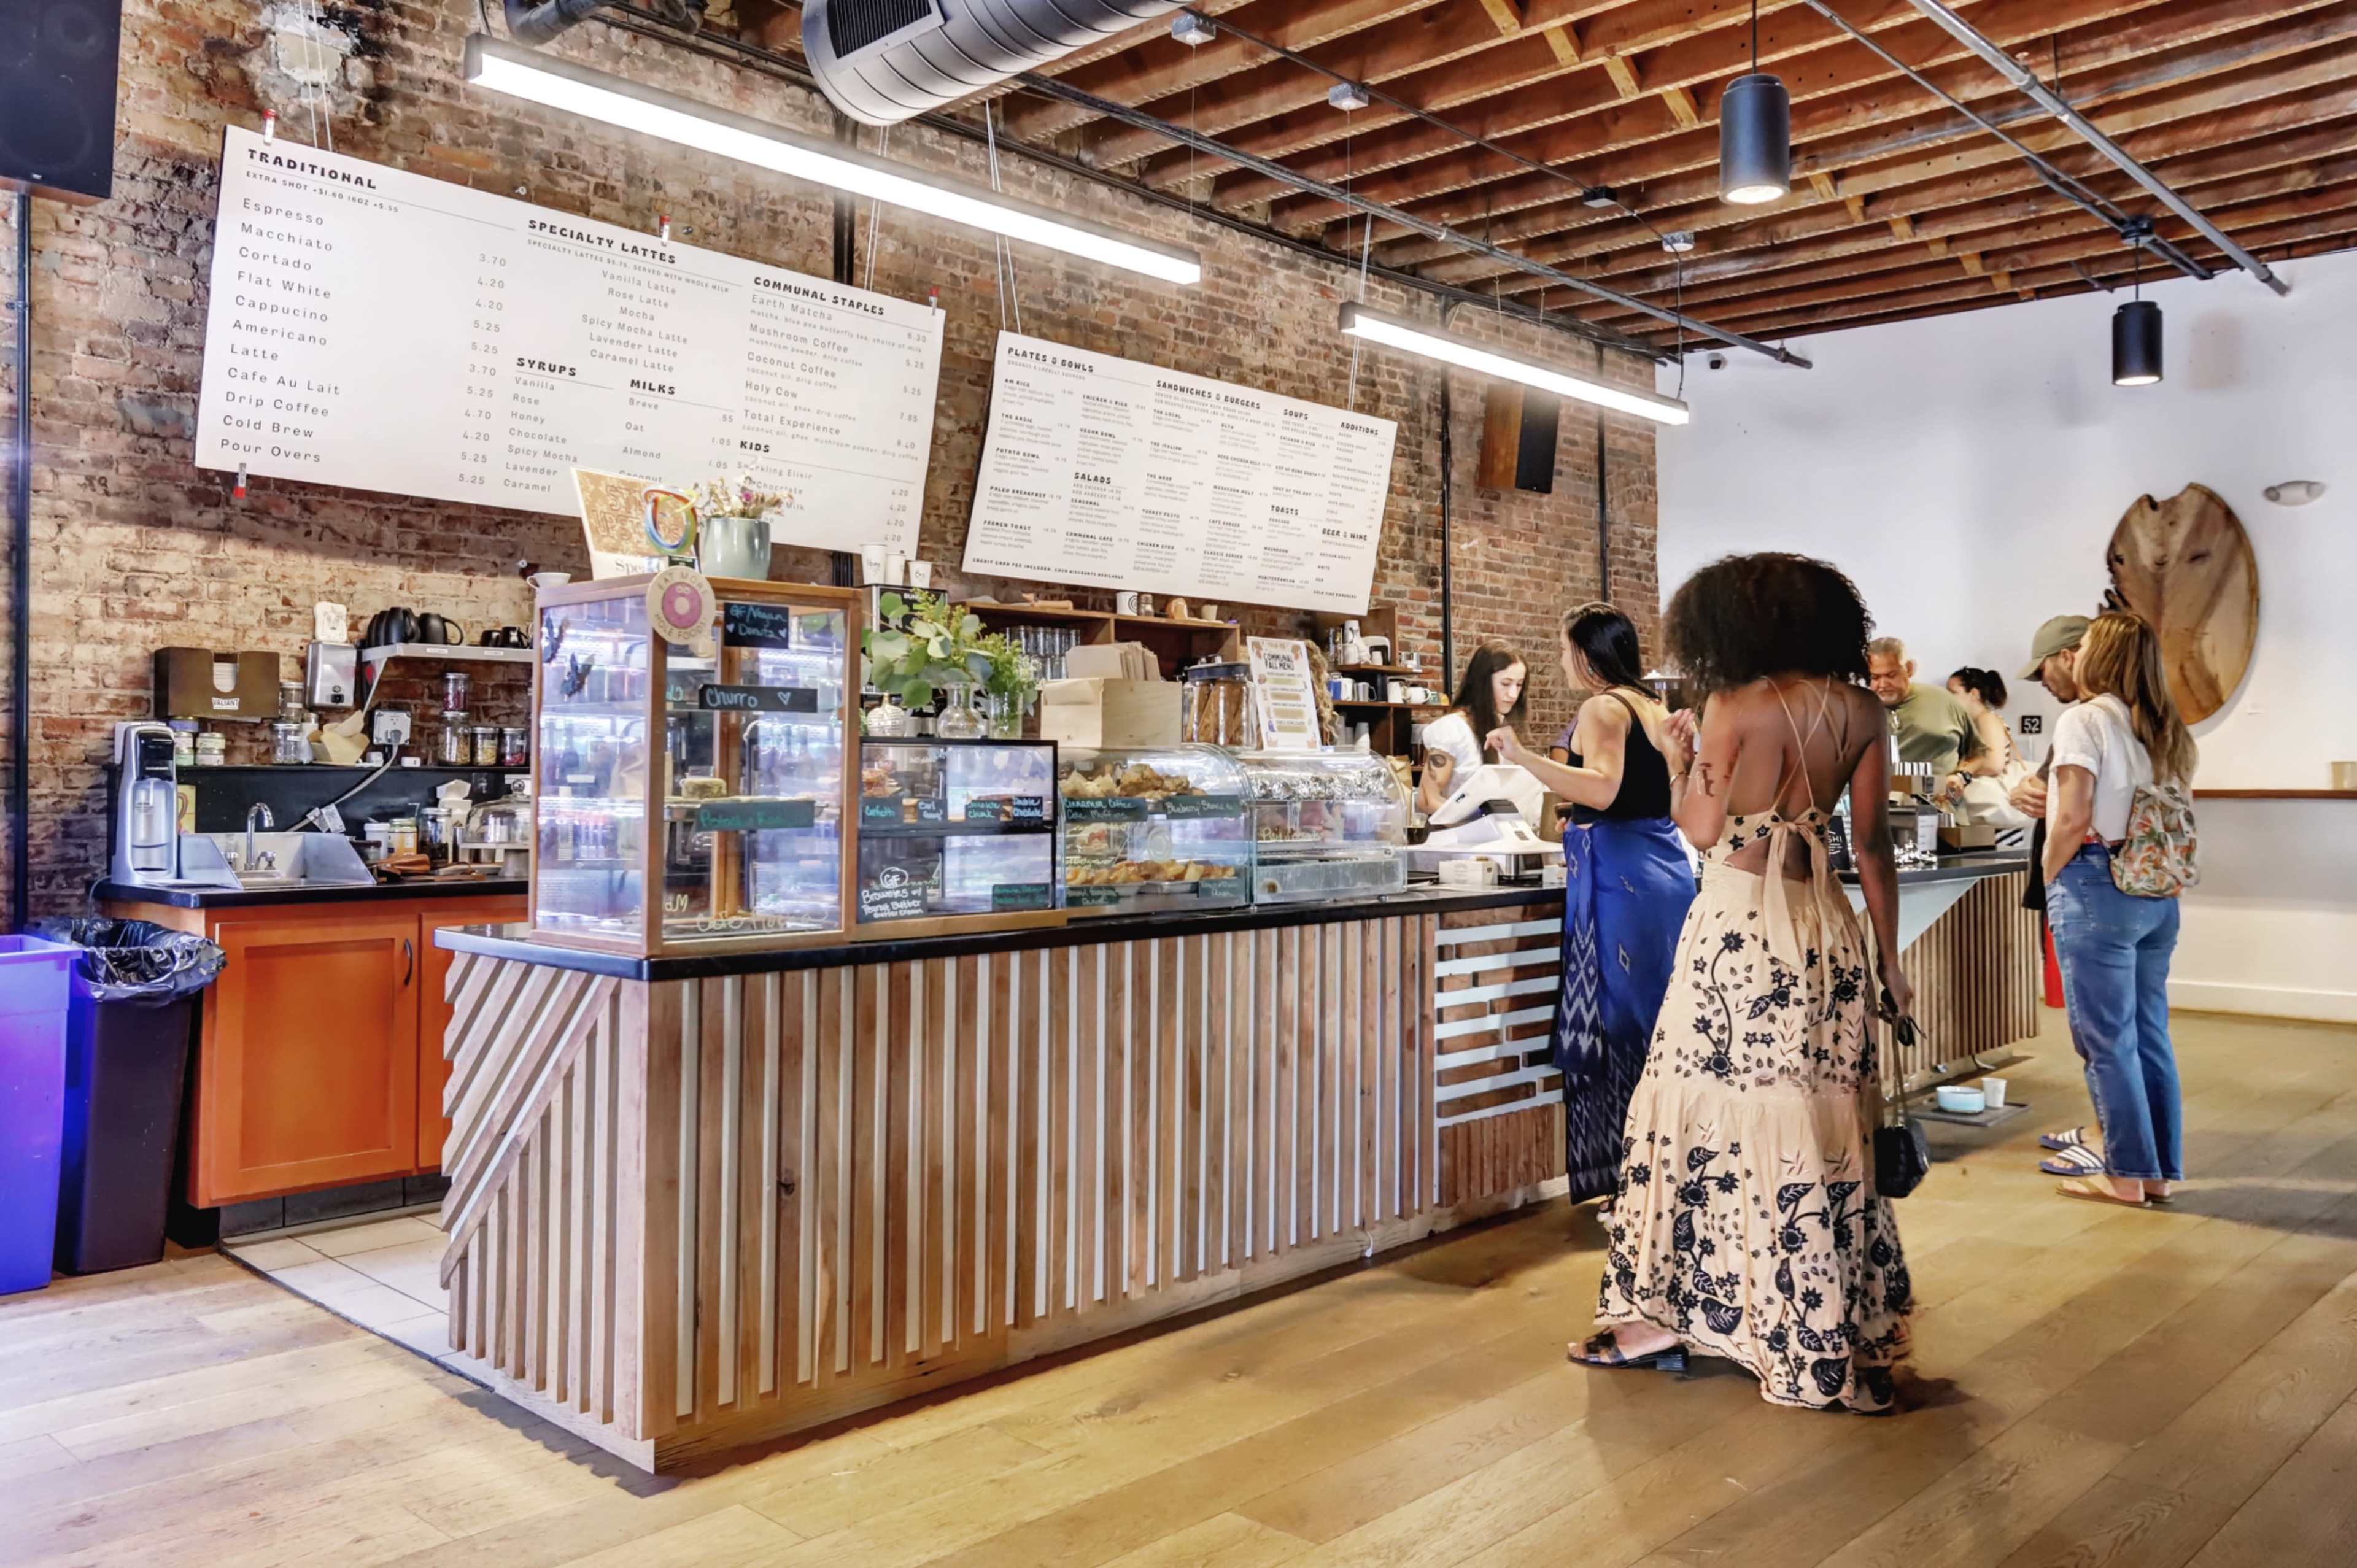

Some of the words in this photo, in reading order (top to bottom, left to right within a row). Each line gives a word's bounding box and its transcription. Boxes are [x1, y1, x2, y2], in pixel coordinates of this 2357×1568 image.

[248, 149, 376, 190] TRADITIONAL
[246, 171, 277, 183] EXTRA
[282, 180, 308, 190] SHOT
[243, 198, 323, 225] Espresso
[241, 222, 332, 251] Macchiato
[528, 220, 614, 248] SPECIALTY
[621, 242, 675, 264] LATTES
[239, 246, 311, 271] Cortado
[479, 253, 506, 267] 3.70
[528, 239, 571, 254] SPECIALTY
[575, 250, 603, 262] LATTES
[633, 265, 661, 276] SERVED
[664, 272, 683, 281] WITH
[685, 278, 708, 288] WHOLE
[238, 271, 271, 287] Flat
[282, 280, 330, 299] White
[477, 277, 505, 289] 4.20
[602, 269, 642, 287] Vanilla
[647, 280, 676, 295] Latte
[608, 287, 634, 301] Rose
[639, 294, 668, 309] Latte
[754, 277, 826, 301] COMMUNAL
[832, 295, 884, 315] STAPLES
[235, 295, 328, 322] Cappucino
[476, 299, 503, 311] 4.20
[751, 294, 784, 309] Earth
[790, 303, 832, 321] Matcha
[619, 306, 655, 322] Mocha
[233, 319, 327, 346] Americano
[473, 320, 500, 333] 5.25
[582, 314, 613, 330] Spicy
[617, 322, 652, 337] Mocha
[658, 331, 687, 344] Latte
[589, 332, 643, 350] Lavender
[648, 344, 678, 358] Latte
[749, 323, 808, 344] Mushroom
[813, 338, 848, 353] Coffee
[230, 343, 279, 361] Latte
[471, 341, 498, 354] 5.25
[517, 357, 576, 376] SYRUPS
[590, 349, 638, 365] Caramel
[643, 360, 673, 373] Latte
[747, 351, 795, 369] Coconut
[800, 363, 836, 378] Coffee
[1008, 347, 1047, 362] PLATES
[1061, 359, 1093, 373] BOWLS
[469, 363, 497, 376] 3.70
[228, 367, 267, 383] Cafe
[277, 376, 297, 388] Au
[307, 380, 339, 395] Lait
[515, 376, 555, 391] Vanilla
[630, 379, 675, 395] MILKS
[745, 380, 770, 395] Holy
[776, 386, 798, 398] Cow
[467, 385, 493, 398] 5.25
[513, 393, 540, 406] Rose
[1156, 380, 1212, 398] SANDWICHES
[1224, 395, 1260, 409] BURGERS
[226, 391, 264, 408] Drip
[273, 398, 329, 417] Coffee
[629, 397, 659, 410] Breve
[464, 409, 492, 420] 4.70
[511, 411, 546, 425] Honey
[745, 409, 774, 423] Total
[780, 415, 840, 435] Experience
[1283, 409, 1308, 420] SOUPS
[223, 415, 261, 430] Cold
[272, 422, 313, 438] Brew
[625, 422, 644, 432] Oat
[1341, 422, 1378, 436] ADDITIONS
[463, 431, 490, 442] 4.20
[509, 427, 567, 444] Chocolate
[711, 437, 731, 446] 1.05
[220, 439, 261, 454] Pour
[271, 446, 320, 462] Overs
[507, 444, 538, 458] Spicy
[543, 450, 578, 463] Mocha
[622, 446, 661, 460] Almond
[740, 441, 770, 453] KIDS
[461, 451, 487, 463] 5.25
[708, 461, 727, 469] 1.05
[505, 462, 558, 476] Lavender
[459, 473, 485, 485] 5.25
[503, 478, 551, 492] Caramel
[1074, 472, 1111, 484] SALADS
[1271, 504, 1298, 516] TOASTS
[1263, 653, 1293, 663] COMMUNAL
[1265, 660, 1278, 670] FALL
[1279, 662, 1294, 670] MENU
[212, 698, 240, 706] VALIANT
[706, 689, 759, 708] Churro
[2023, 717, 2040, 732] 52
[884, 874, 901, 888] GF
[861, 889, 909, 904] Brownies
